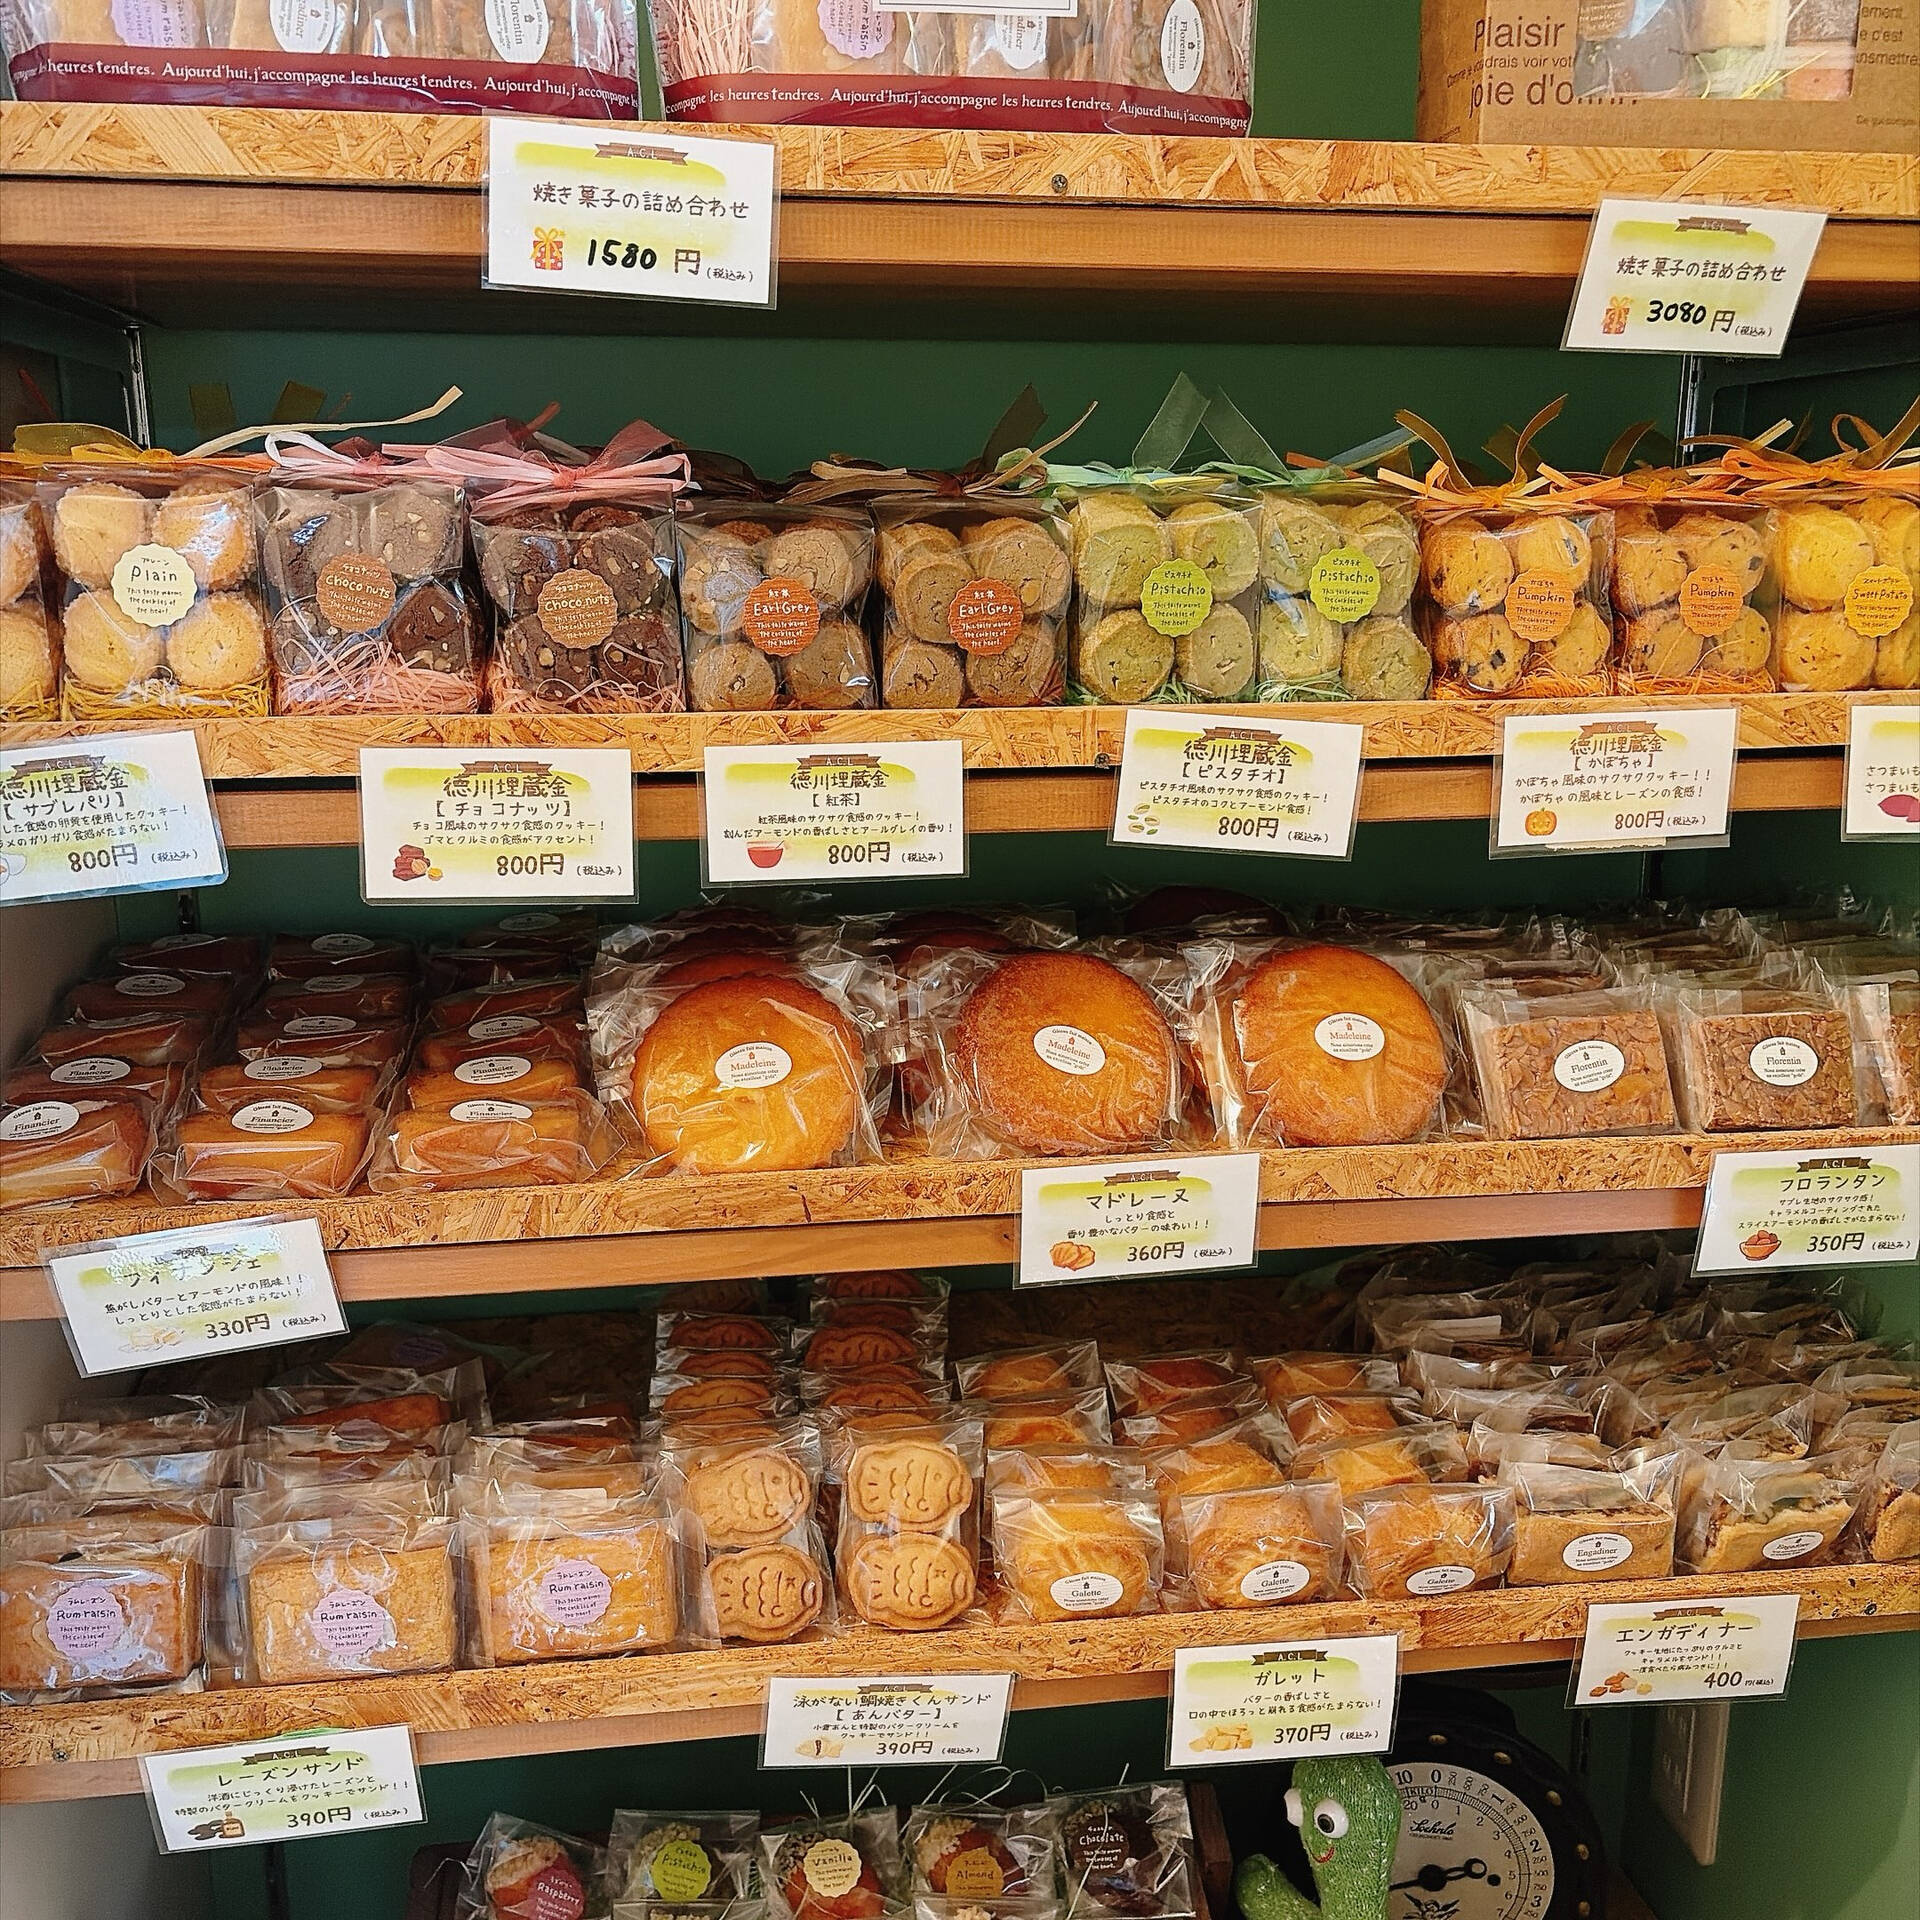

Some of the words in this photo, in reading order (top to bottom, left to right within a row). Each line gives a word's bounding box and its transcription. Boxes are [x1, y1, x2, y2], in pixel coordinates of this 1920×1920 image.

[1474, 16, 1566, 52] Plaisir
[1178, 21, 1188, 70] Florentin
[1523, 56, 1548, 68] voir
[47, 59, 94, 75] heures
[96, 60, 154, 76] tendres.
[253, 65, 346, 87] j'accompagne
[351, 71, 372, 85] les
[373, 72, 418, 88] heures
[420, 73, 477, 90] tendres.
[709, 90, 724, 102] les
[727, 88, 770, 101] heures
[771, 87, 824, 102] tendres.
[913, 90, 998, 110] j'accompagne
[1002, 94, 1018, 107] les
[1021, 96, 1063, 109] heures
[1065, 96, 1114, 112] tendres.
[1469, 74, 1514, 119] joie
[532, 181, 750, 219] 焼き菓子の詰め合わせ
[587, 238, 657, 270] 1580
[675, 248, 701, 275] 円
[707, 267, 753, 283] （税込み）
[1616, 256, 1787, 282] 焼き菓子の詰め合わせ
[1646, 300, 1707, 325] 3080
[1710, 310, 1735, 333] 円
[131, 565, 178, 582] Plain
[1320, 569, 1374, 583] Pistachio
[366, 584, 391, 599] nuts
[1151, 582, 1206, 597] Pistachio
[1517, 586, 1565, 604] Pumpkin
[1690, 583, 1735, 599] Pumpkin
[1853, 588, 1878, 600] Sweet
[1879, 588, 1908, 600] Potato
[585, 593, 610, 606] nuts
[754, 602, 779, 616] Earl
[781, 601, 811, 614] Grey
[959, 603, 984, 618] Earl
[986, 602, 1014, 615] Grey
[1570, 733, 1667, 756] 徳川埋蔵金
[1183, 739, 1298, 767] 徳川埋蔵金
[1574, 753, 1655, 771] 【かぼちゃ】
[790, 769, 890, 791] 徳川埋蔵金
[1182, 762, 1285, 784] 【ピスタチオ】
[443, 775, 573, 799] 徳川埋蔵金
[3, 791, 125, 821] 【サブレパリ】
[812, 792, 860, 808] 【紅茶】
[437, 800, 572, 818] 【チョコナッツ】
[1615, 810, 1665, 830] 800円
[1667, 816, 1706, 827] （税込み）
[1218, 816, 1280, 839] 800円
[1287, 831, 1329, 844] （税込み）
[67, 843, 139, 873] 800円
[151, 849, 198, 865] （税込み）
[828, 841, 891, 865] 800円
[901, 851, 944, 863] （税込み）
[496, 853, 565, 876] 800円
[576, 866, 622, 877] （税込み）
[1330, 1032, 1372, 1040] Madeleine
[1048, 1040, 1091, 1060] Madeleine
[730, 1060, 777, 1072] Madeleine
[1571, 1059, 1608, 1074] Florentin
[1766, 1056, 1802, 1065] Florentin
[14, 1117, 60, 1132] Financier
[1780, 1174, 1885, 1192] フロランタン
[1086, 1188, 1189, 1210] マドレーヌ
[1105, 1210, 1175, 1224] しっとり食感と
[1807, 1232, 1865, 1253] 350円
[1127, 1241, 1185, 1262] 360円
[205, 1312, 270, 1340] 330円
[282, 1313, 326, 1328] （税込み）
[1577, 1547, 1618, 1559] Engadiner
[549, 1584, 571, 1594] Rum
[574, 1581, 604, 1590] raisin
[1261, 1577, 1290, 1588] Galette
[1071, 1588, 1101, 1598] Galette
[57, 1610, 81, 1621] Rum
[83, 1610, 116, 1618] raisin
[320, 1612, 344, 1622] Rum
[346, 1611, 377, 1619] raisin
[1616, 1622, 1754, 1643] エンガディナー
[1254, 1668, 1325, 1686] ガレット
[1704, 1671, 1743, 1689] 400
[793, 1693, 992, 1708] 泳がない鯛焼きくんサンド
[1243, 1691, 1330, 1704] バターの香ばしさと
[836, 1708, 941, 1721] 【あんバター】
[1273, 1723, 1331, 1744] 370円
[876, 1740, 933, 1755] 390円
[218, 1756, 365, 1787] レーズンサンド
[1395, 1770, 1412, 1785] 10
[1431, 1769, 1441, 1783] 0
[1404, 1800, 1418, 1810] 20
[1431, 1800, 1439, 1809] 0
[287, 1806, 351, 1828] 390円
[1476, 1816, 1484, 1827] 2
[1080, 1832, 1124, 1846] Chocolate
[1493, 1831, 1500, 1841] 3
[1530, 1840, 1542, 1852] 2
[662, 1853, 706, 1873] Pistachio
[812, 1855, 852, 1867] Vanilla
[955, 1869, 994, 1881] Almond
[1508, 1871, 1516, 1881] 5
[537, 1882, 580, 1905] Raspberry
[1505, 1891, 1512, 1900] 6
[1531, 1895, 1541, 1907] 3
